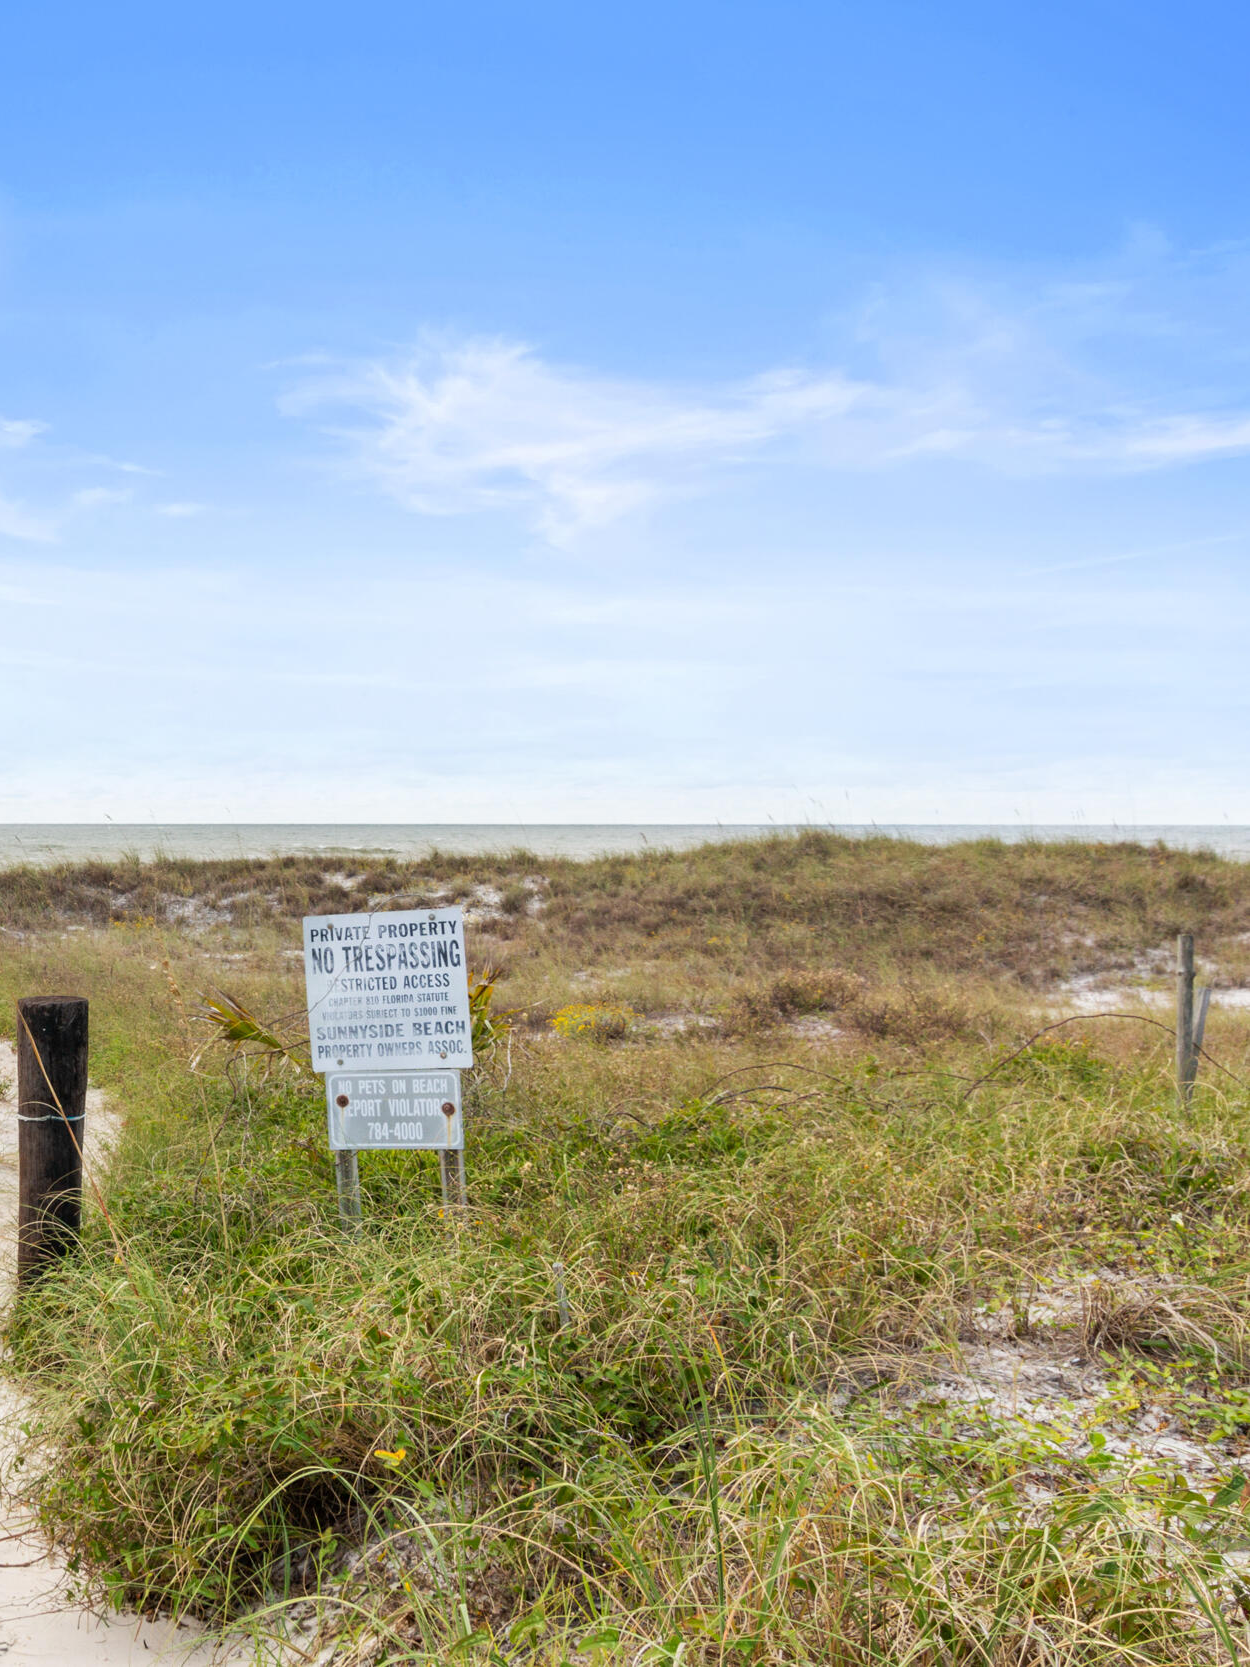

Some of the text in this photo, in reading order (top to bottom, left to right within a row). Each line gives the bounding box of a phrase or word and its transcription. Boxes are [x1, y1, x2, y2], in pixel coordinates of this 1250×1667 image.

[310, 920, 457, 942] PRIVATE PROPERTY
[312, 939, 461, 974] NO TRESPASSING
[403, 973, 450, 989] ACCESS
[382, 993, 414, 1005] FLORIDA
[417, 992, 449, 1003] STATUTE
[401, 1007, 411, 1018] TO
[440, 1005, 458, 1016] FINE
[317, 1020, 466, 1041] SUNNYSIDE BEACH
[318, 1039, 467, 1059] PROPERTY OWNERS ASSOC.
[338, 1078, 448, 1094] NO PETS ON BEACH
[340, 1098, 382, 1117] EPORT
[367, 1122, 423, 1140] 784-4000
